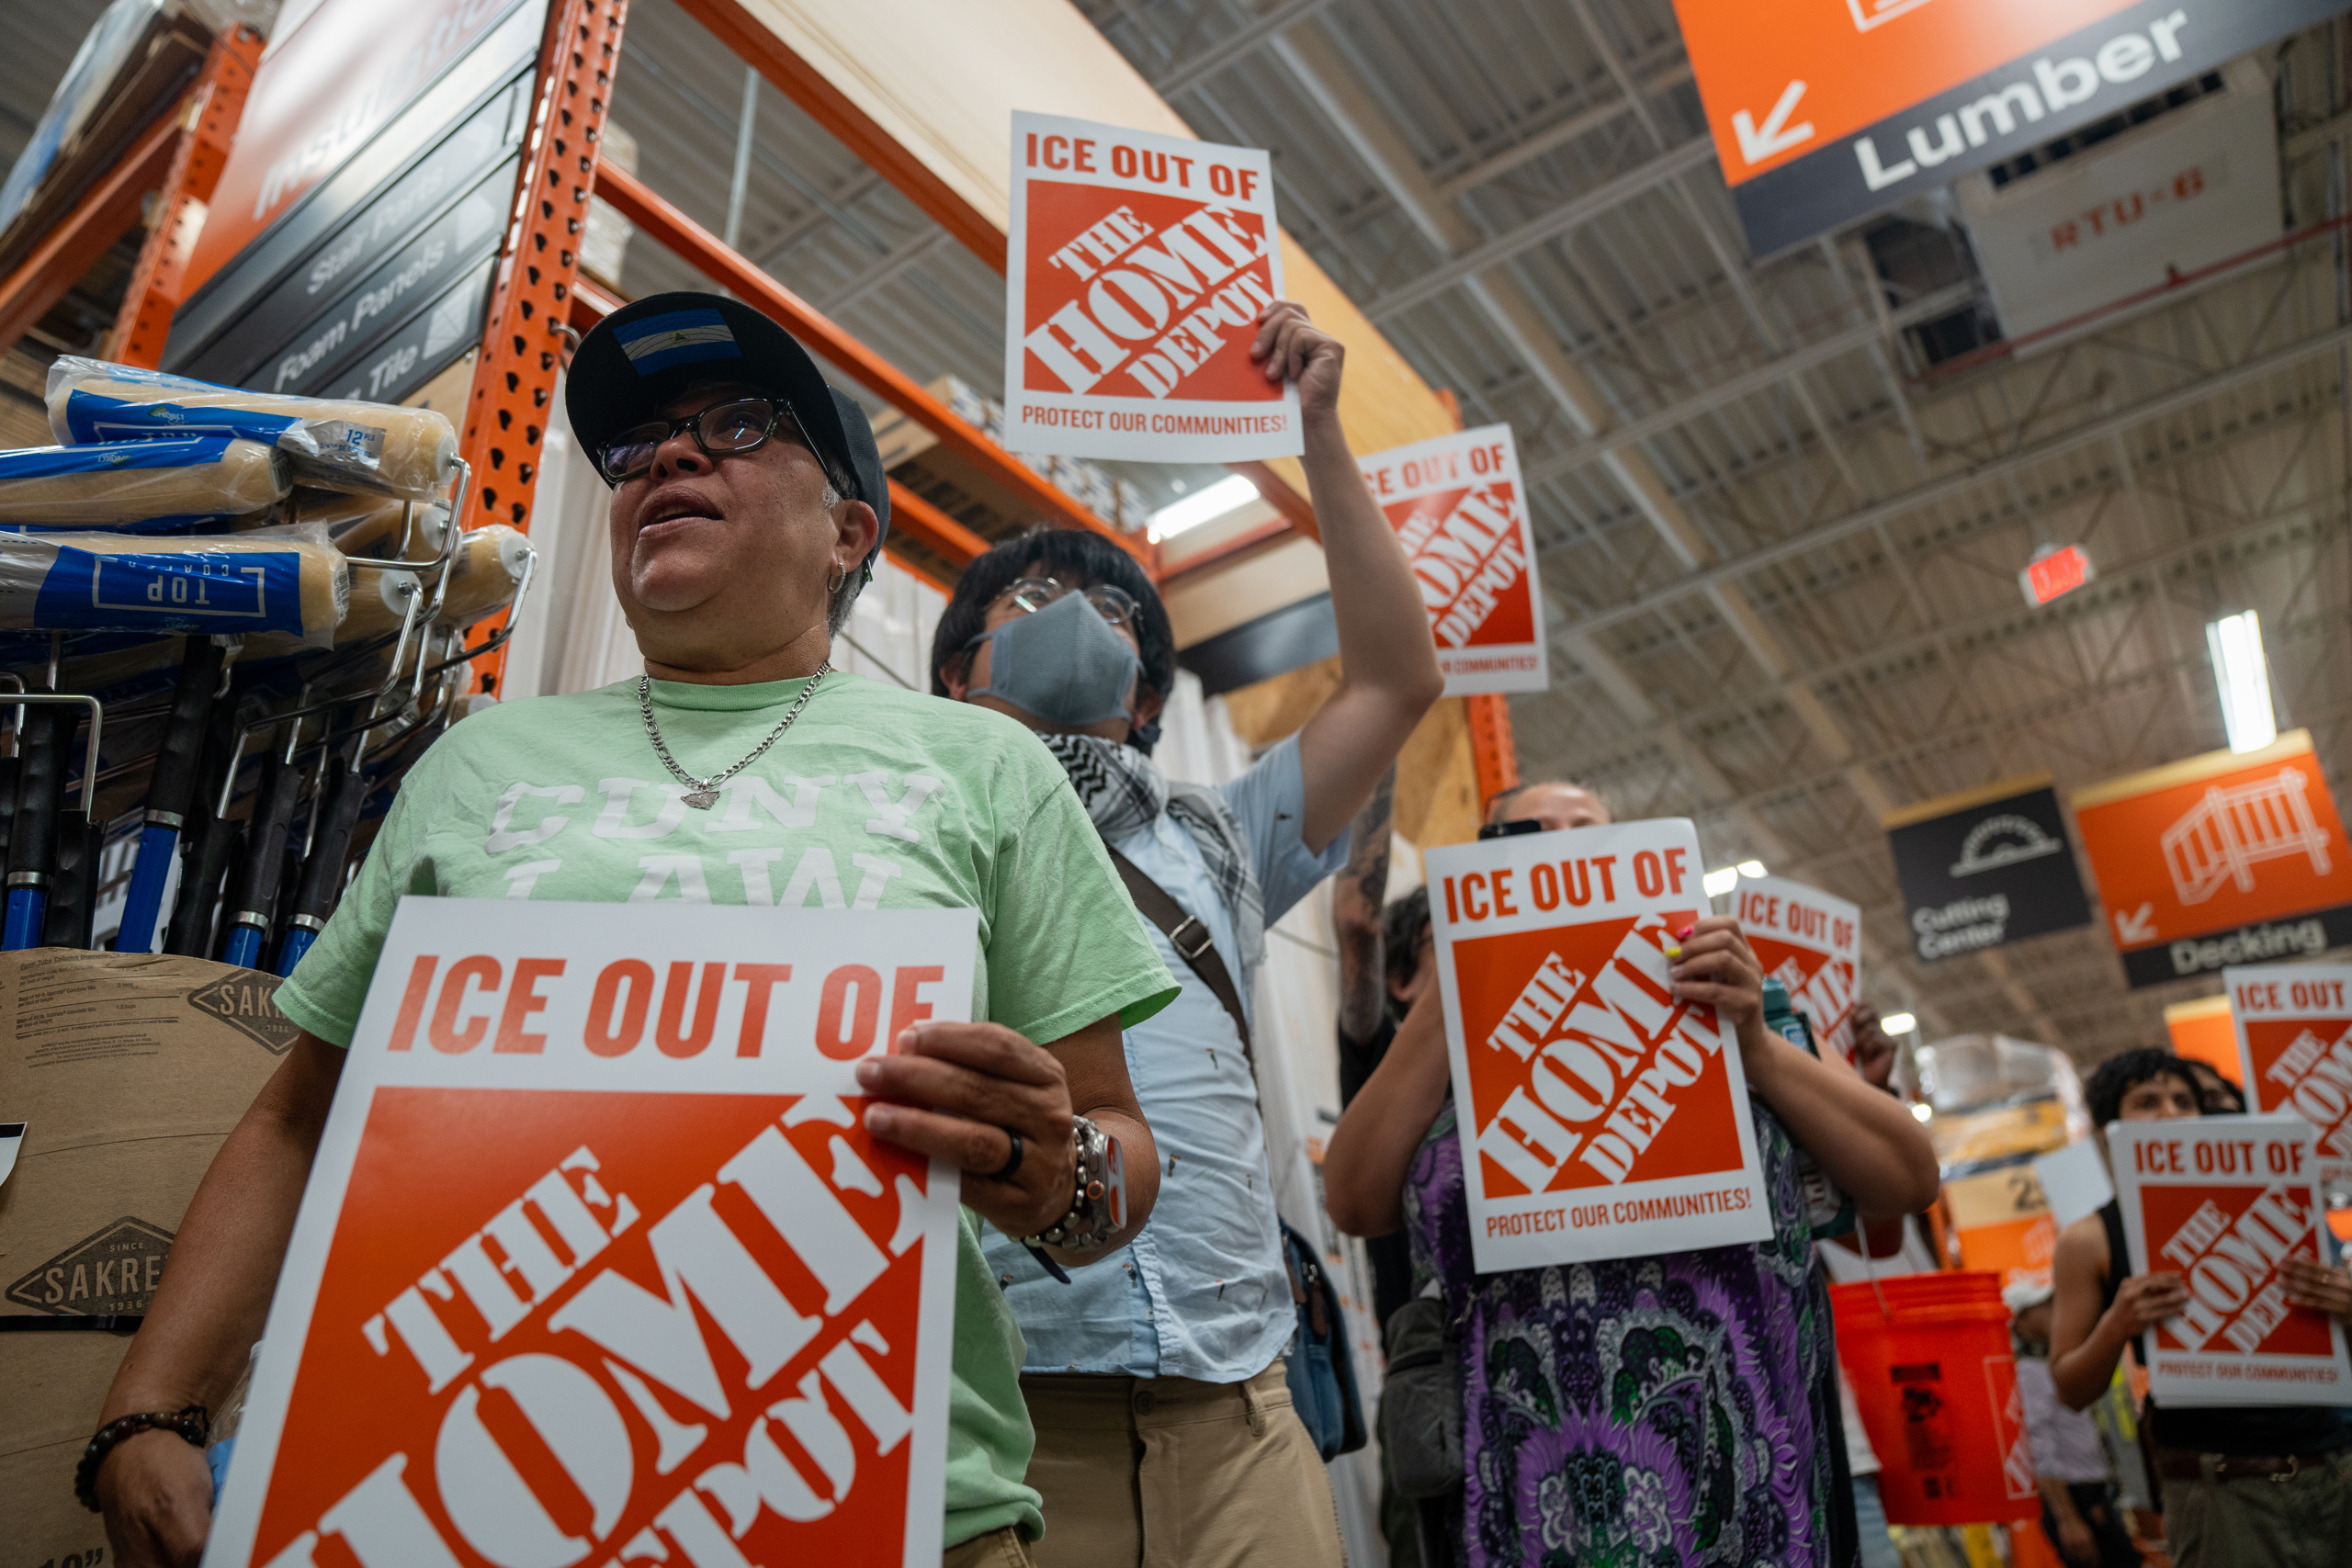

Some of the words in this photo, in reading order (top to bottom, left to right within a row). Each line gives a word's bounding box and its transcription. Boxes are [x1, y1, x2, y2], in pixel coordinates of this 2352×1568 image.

[253, 0, 492, 221] Insulatio
[1852, 8, 2190, 193] Lumber
[1025, 132, 1097, 173] ICE
[1112, 145, 1194, 189] OUT
[1208, 164, 1259, 202] OF
[306, 231, 368, 295] Stair
[1048, 205, 1155, 282] THE
[273, 321, 347, 393] Foam
[351, 240, 447, 332] Panels
[1024, 203, 1268, 395] HOME
[1125, 270, 1274, 400] DEPOT
[369, 344, 419, 398] Tile
[346, 429, 363, 446] 12
[1022, 405, 1105, 430] PROTECT
[1109, 412, 1148, 434] OUR
[1151, 414, 1288, 435] COMMUNITIES!
[1401, 451, 1459, 489] OUT
[1469, 443, 1505, 474] OF
[1409, 484, 1518, 626] OME
[148, 575, 210, 604] TOP
[1436, 536, 1526, 649] DEPOT
[483, 771, 946, 854] CUNY
[1442, 868, 1519, 924] ICE
[1530, 855, 1617, 913] OUT
[1633, 847, 1688, 899] OF
[1738, 891, 1780, 929] ICE
[1786, 900, 1827, 942] OUT
[1832, 918, 1853, 951] OF
[2170, 919, 2328, 976] Decking
[220, 984, 286, 1019] SAK
[386, 953, 567, 1058] ICE
[582, 957, 795, 1061] OUT
[814, 963, 945, 1063] OF
[1487, 951, 1587, 1063] THE
[2235, 981, 2282, 1010] ICE
[2290, 979, 2345, 1010] OUT
[2266, 1028, 2328, 1089] THE
[1579, 1006, 1723, 1185] DEPOT
[2134, 1140, 2185, 1174] ICE
[2194, 1140, 2254, 1174] OUT
[2267, 1140, 2305, 1175] OF
[109, 1242, 144, 1252] SINCE
[1486, 1207, 1566, 1239] PROTECT
[1572, 1201, 1611, 1228] OUR
[1613, 1188, 1752, 1224] COMMUNITIES!
[2161, 1198, 2233, 1269] THE
[45, 1255, 168, 1304] SAKRE
[361, 1144, 641, 1396] THE
[108, 1300, 142, 1312] 1936
